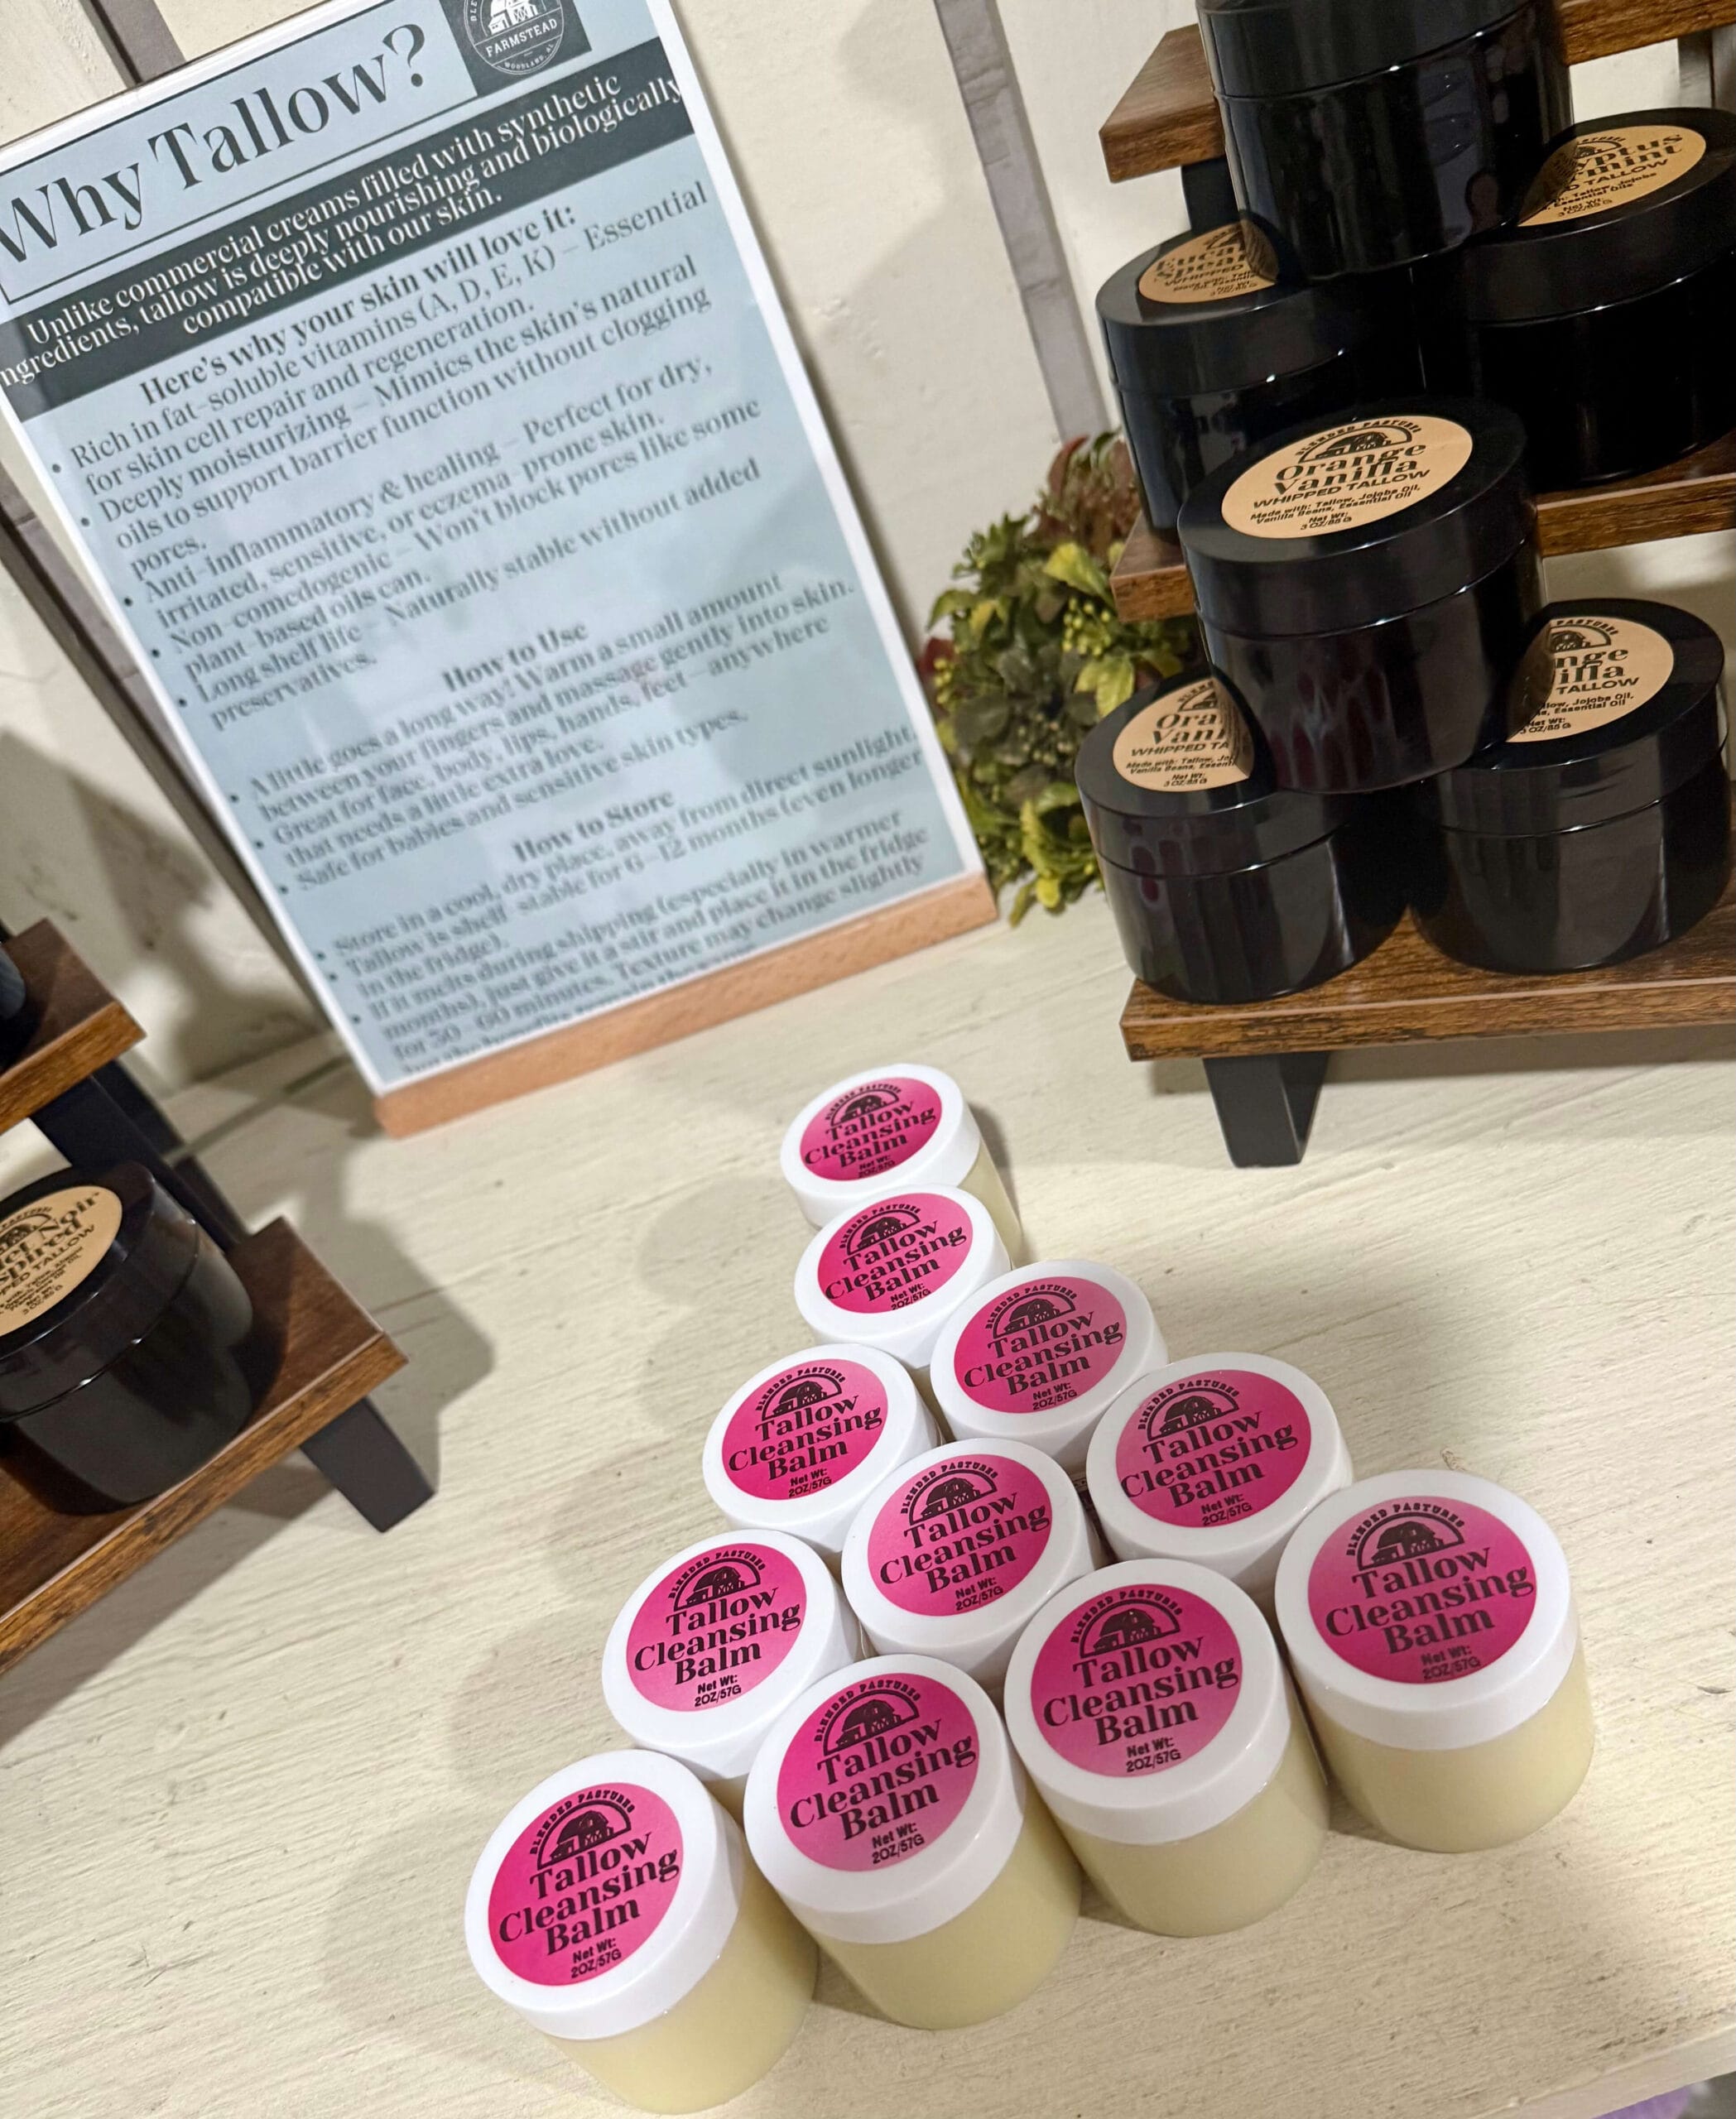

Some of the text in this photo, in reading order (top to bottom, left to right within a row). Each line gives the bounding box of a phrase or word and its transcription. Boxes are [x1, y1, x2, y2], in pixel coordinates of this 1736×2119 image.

[486, 18, 558, 57] FARMSTEAD
[0, 24, 424, 262] Why Tallow?
[1584, 159, 1668, 185] TALLOW
[0, 73, 684, 386] ngredients, tallow is deeply nourishing and biologically
[26, 76, 620, 343] Unlike commercial creams filled with synthetic
[183, 185, 501, 333] compatible with our skin.
[70, 430, 130, 468] Rich
[130, 420, 161, 443] in
[301, 310, 416, 368] vitamins
[418, 292, 457, 320] (A,
[458, 279, 490, 303] D,
[491, 263, 521, 289] E,
[522, 245, 555, 276] K)
[584, 180, 707, 250] Essential
[139, 207, 575, 405] Here's why your skin will love it:
[85, 298, 533, 495] for skin cell repair and regeneration.
[98, 254, 696, 521] Deeply moisturizing Mimics the skin's natural
[115, 287, 710, 548] oils to support barrier function without clogging
[379, 482, 402, 503] &
[402, 441, 500, 493] healing
[523, 393, 613, 444] Perfect
[615, 377, 652, 406] for
[658, 358, 711, 388] dry,
[1253, 469, 1431, 509] WHIPPED TALLOW
[1273, 459, 1417, 495] Vanilla
[1275, 444, 1426, 482] Orange
[155, 571, 267, 633] irritated,
[267, 527, 386, 583] sensitive,
[387, 510, 413, 532] or
[599, 411, 663, 446] skin.
[1250, 483, 1421, 521] Made with: Tallow, Jojoba Oil,
[1257, 491, 1411, 525] Vanilla Beans, Essential Oil
[1309, 512, 1349, 523] Net Wt:
[132, 540, 208, 581] pores.
[441, 625, 587, 691] How to Use
[1555, 702, 1606, 714] Essential
[1556, 677, 1640, 694] TALLOW
[1574, 695, 1611, 705] Jojoba
[1131, 743, 1205, 757] WHIPPED
[512, 792, 673, 862] How to Store
[805, 1108, 935, 1164] Cleansing
[826, 1101, 914, 1141] Tallow
[839, 1135, 908, 1168] Balm
[33, 1224, 95, 1271] TALLOW
[825, 1227, 966, 1299] Cleansing
[844, 1220, 938, 1271] Tallow
[864, 1259, 940, 1301] Balm
[964, 1322, 1123, 1386] Cleansing
[988, 1311, 1094, 1358] Tallow
[1007, 1357, 1091, 1395] Balm
[729, 1407, 882, 1470] Cleansing
[756, 1395, 859, 1441] Tallow
[1142, 1411, 1262, 1464] Tallow
[768, 1441, 849, 1480] Balm
[1121, 1425, 1297, 1497] Cleansing
[1169, 1463, 1264, 1507] Balm
[881, 1505, 1050, 1583] Cleansing
[904, 1492, 1017, 1549] Tallow
[1347, 1503, 1464, 1555] BLENDED PASTURES
[926, 1545, 1017, 1593] Balm
[1352, 1548, 1490, 1599] Tallow
[666, 1588, 778, 1636] Tallow
[1071, 1590, 1183, 1643] BLENDED PASTURES
[1326, 1567, 1533, 1635] Cleansing
[635, 1604, 801, 1670] Cleansing
[1383, 1610, 1495, 1654] Balm
[676, 1643, 762, 1684] Balm
[698, 1675, 738, 1694] Net Wt:
[1073, 1637, 1204, 1689] Tallow
[815, 1680, 921, 1742] BLENDED PASTURES
[1044, 1658, 1238, 1725] Cleansing
[1095, 1702, 1199, 1745] Balm
[817, 1719, 941, 1785] Tallow
[791, 1735, 976, 1826] Cleansing
[530, 1790, 635, 1854] BLENDED PASTURES
[840, 1785, 940, 1840] Balm
[872, 1823, 917, 1848] Net Wt:
[530, 1832, 652, 1900] Tallow
[499, 1849, 679, 1942] Cleansing
[546, 1900, 640, 1955] Balm
[573, 1939, 616, 1963] Net Wt:
